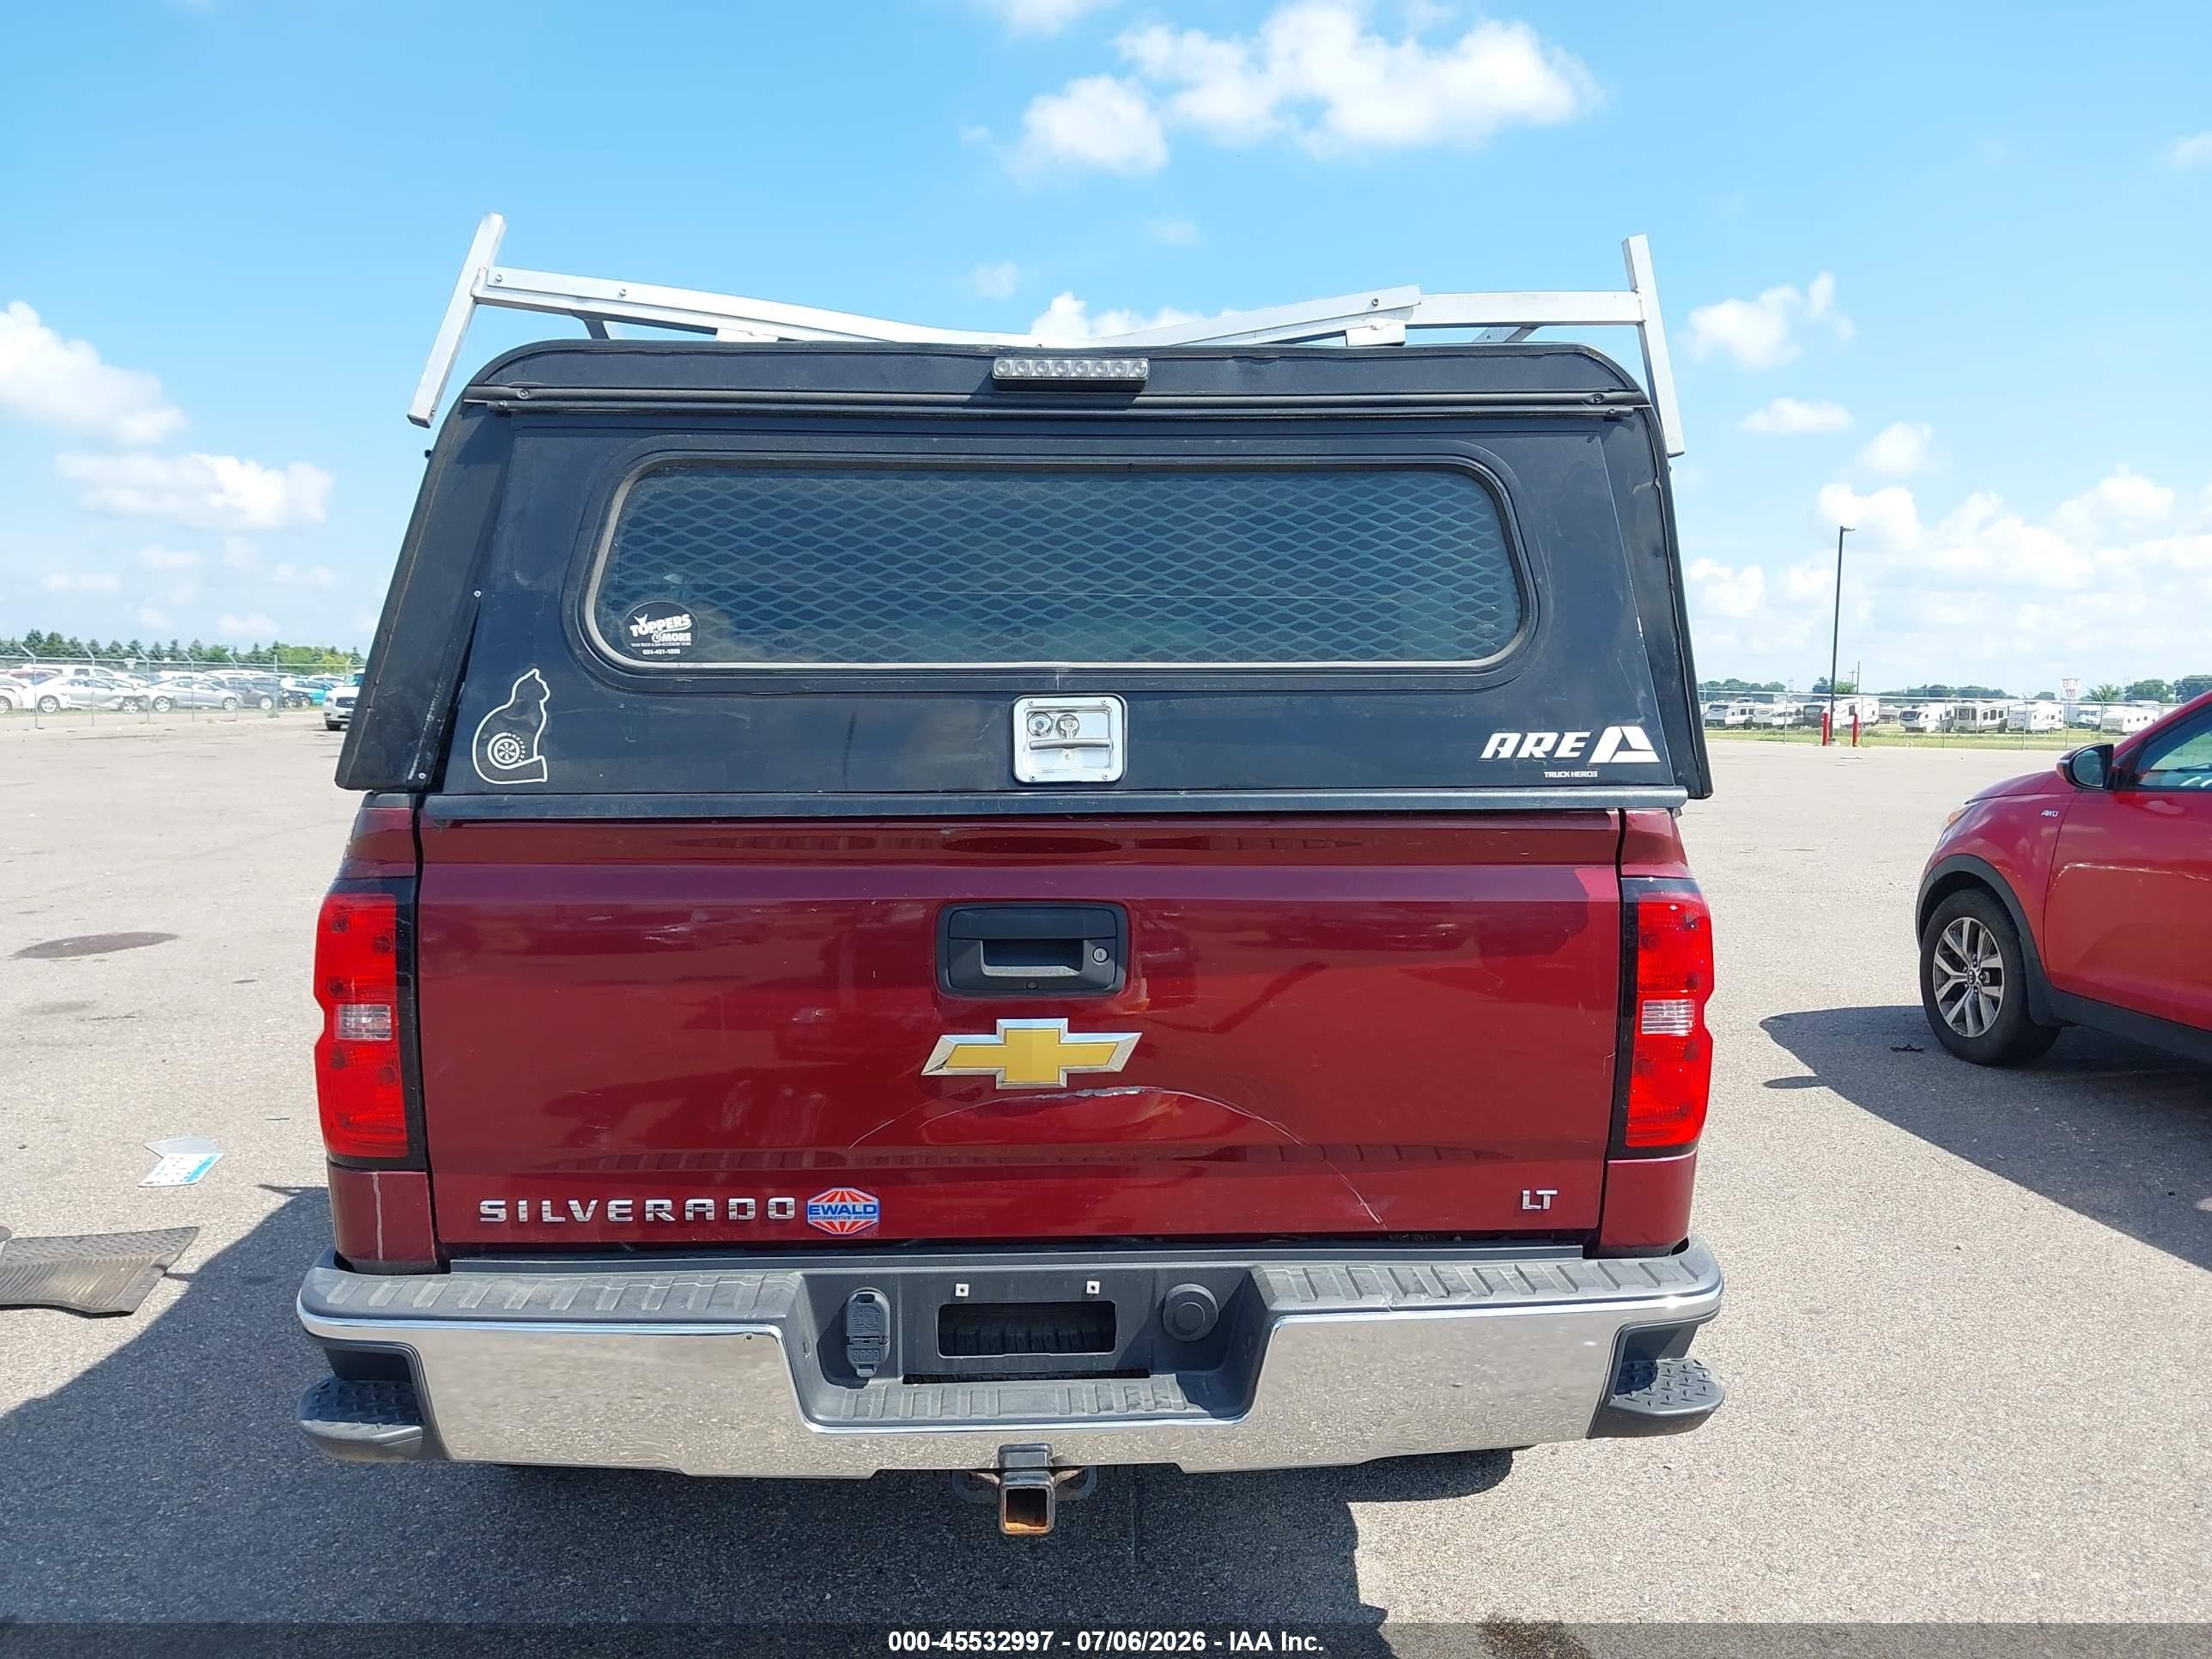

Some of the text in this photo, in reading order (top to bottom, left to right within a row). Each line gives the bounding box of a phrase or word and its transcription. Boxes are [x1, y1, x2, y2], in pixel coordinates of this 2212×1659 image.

[629, 614, 692, 636] TOPPERS
[661, 633, 691, 642] MORE
[1480, 732, 1591, 759] ARE
[480, 1197, 795, 1222] SILVERADO
[808, 1204, 877, 1215] EWALD
[1522, 1189, 1559, 1210] LT
